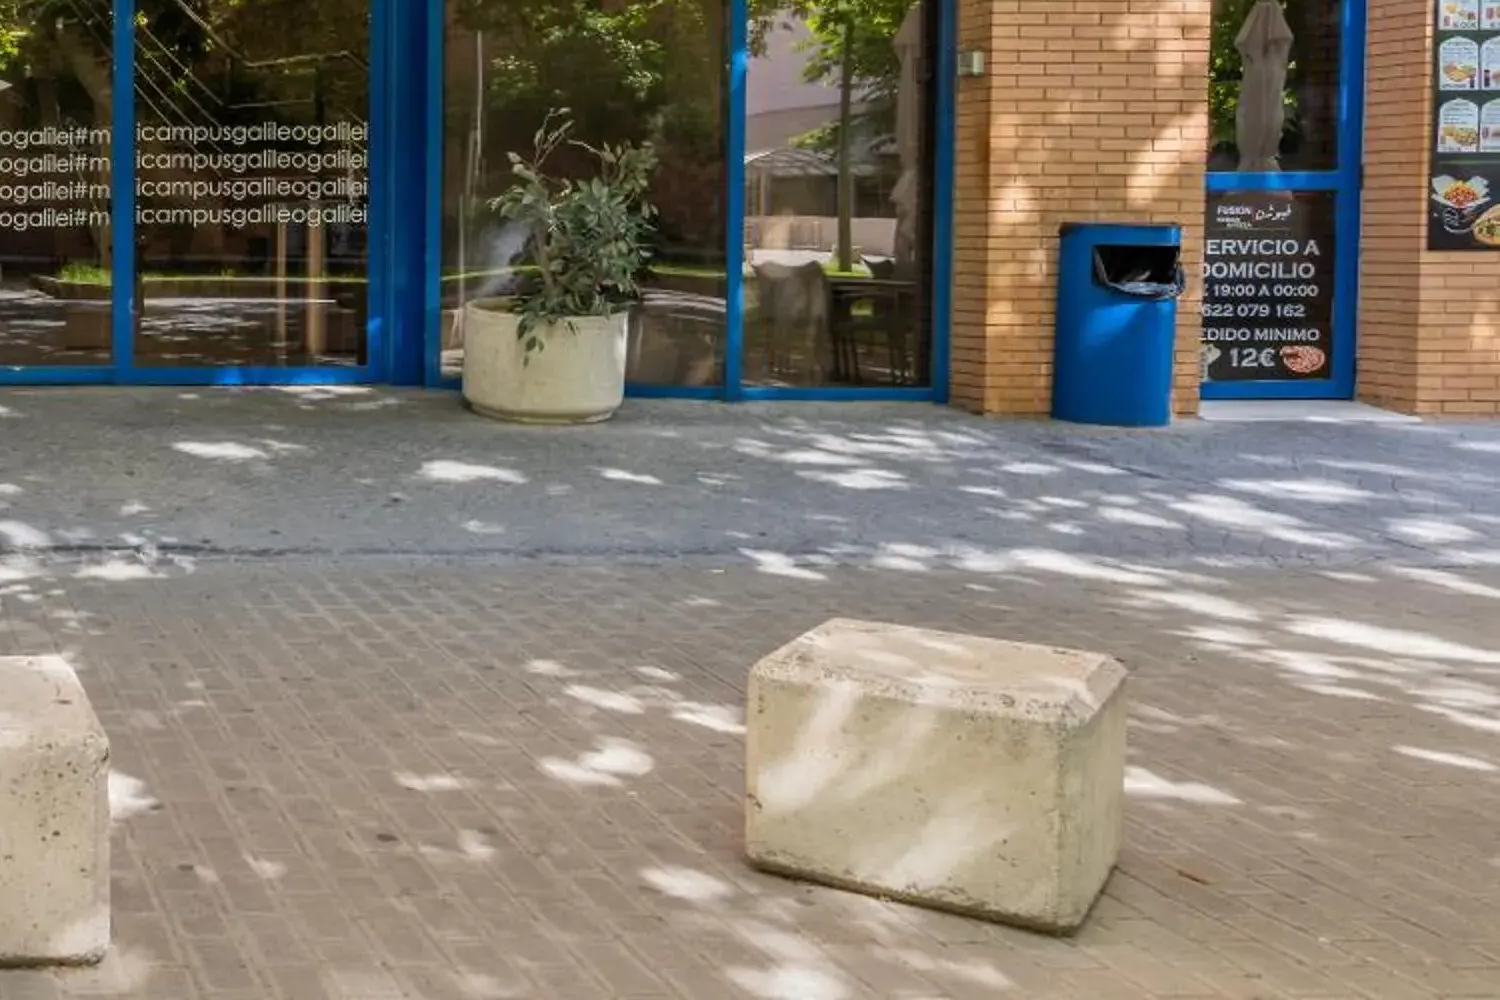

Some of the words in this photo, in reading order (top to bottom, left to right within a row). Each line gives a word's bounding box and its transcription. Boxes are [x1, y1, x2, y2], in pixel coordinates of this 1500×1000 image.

[1206, 239, 1299, 255] ERVICIO
[1303, 239, 1320, 256] A
[1214, 285, 1255, 297] 19:00
[1258, 285, 1270, 297] A
[1273, 285, 1319, 297] 00:00
[1237, 304, 1270, 317] 079
[1253, 328, 1319, 341] MINIMO
[1230, 347, 1276, 367] 12€
